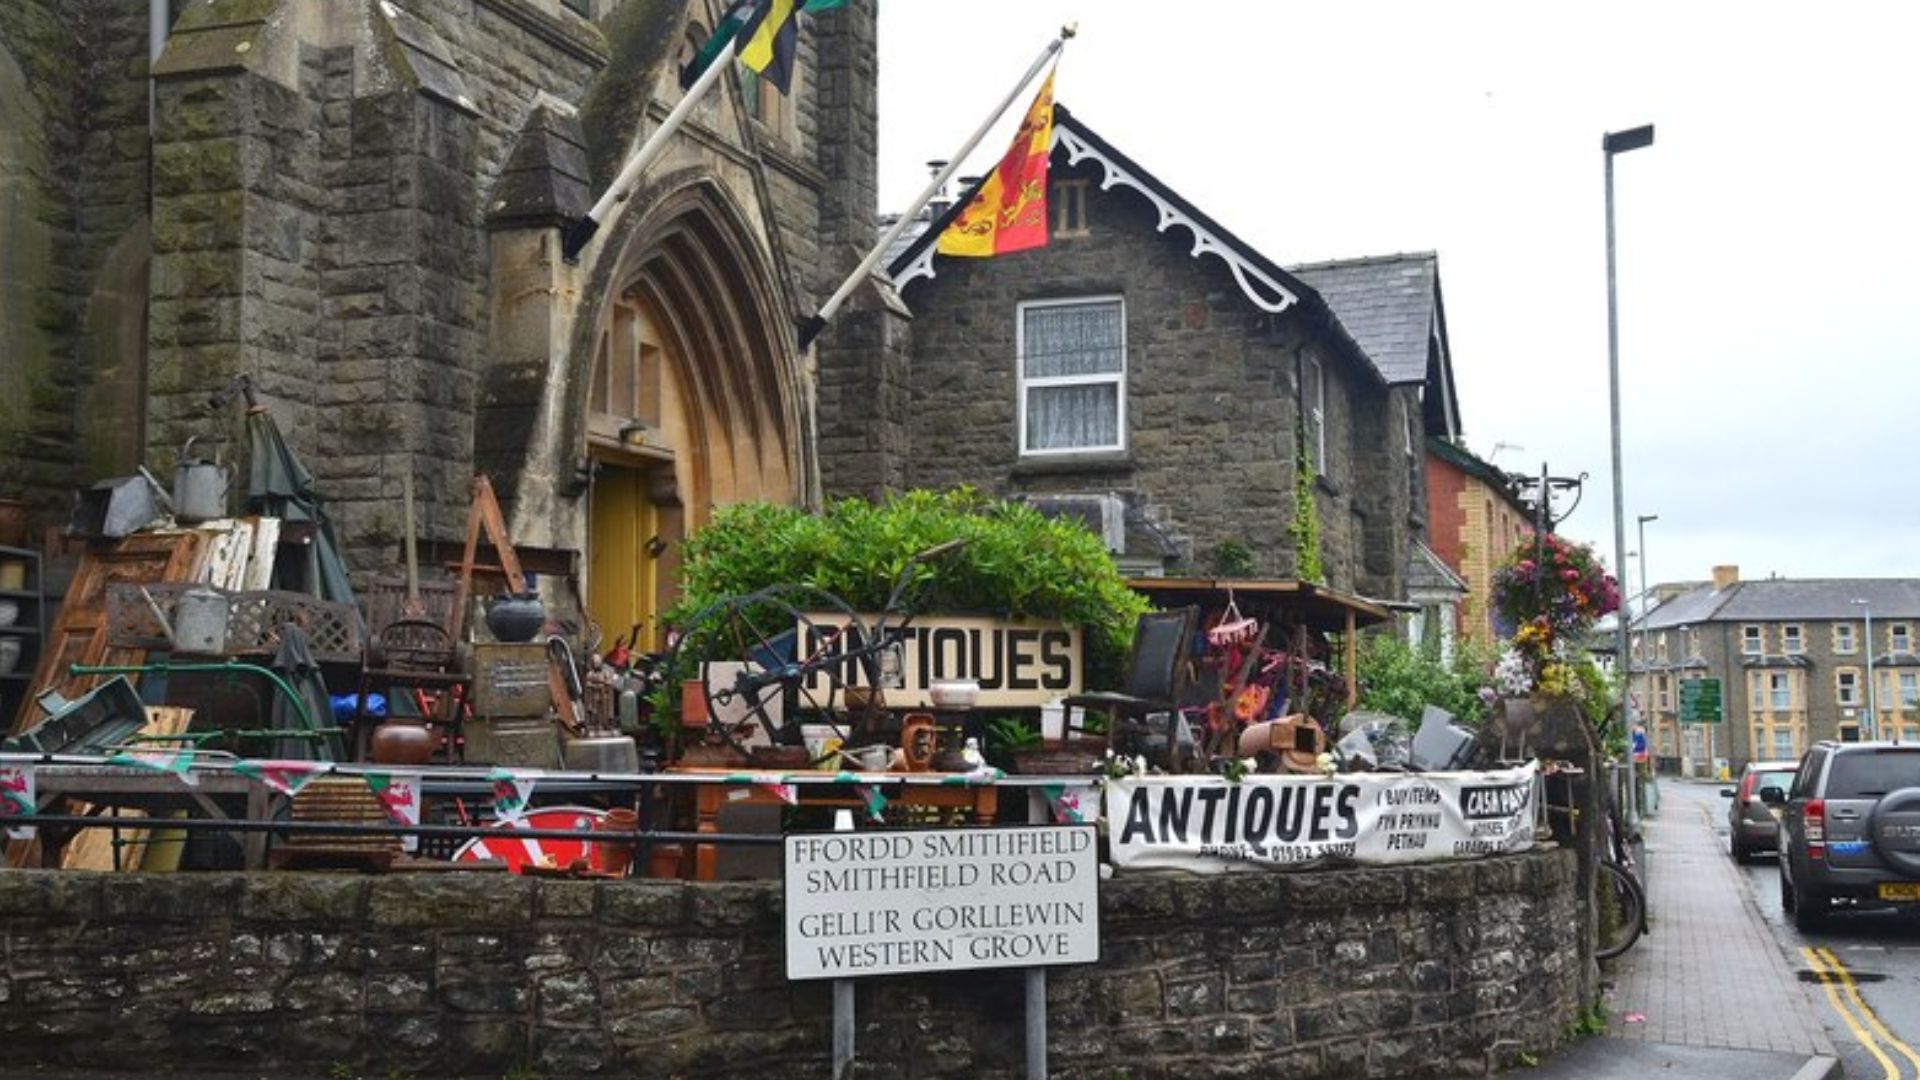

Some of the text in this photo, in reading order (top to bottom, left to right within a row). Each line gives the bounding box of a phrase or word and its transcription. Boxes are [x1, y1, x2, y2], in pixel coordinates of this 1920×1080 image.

[806, 623, 1072, 690] ANTIQUES
[1409, 787, 1441, 804] ITEMS
[1467, 788, 1500, 815] CASH
[1119, 784, 1361, 857] ANTIQUES
[794, 829, 1091, 864] FFORDD SMITHFIELD
[806, 860, 1077, 894] SMITHFIELD ROAD
[799, 902, 1085, 939] GELLI'R GORLLEWIN
[817, 933, 1070, 970] WESTERN GROVE
